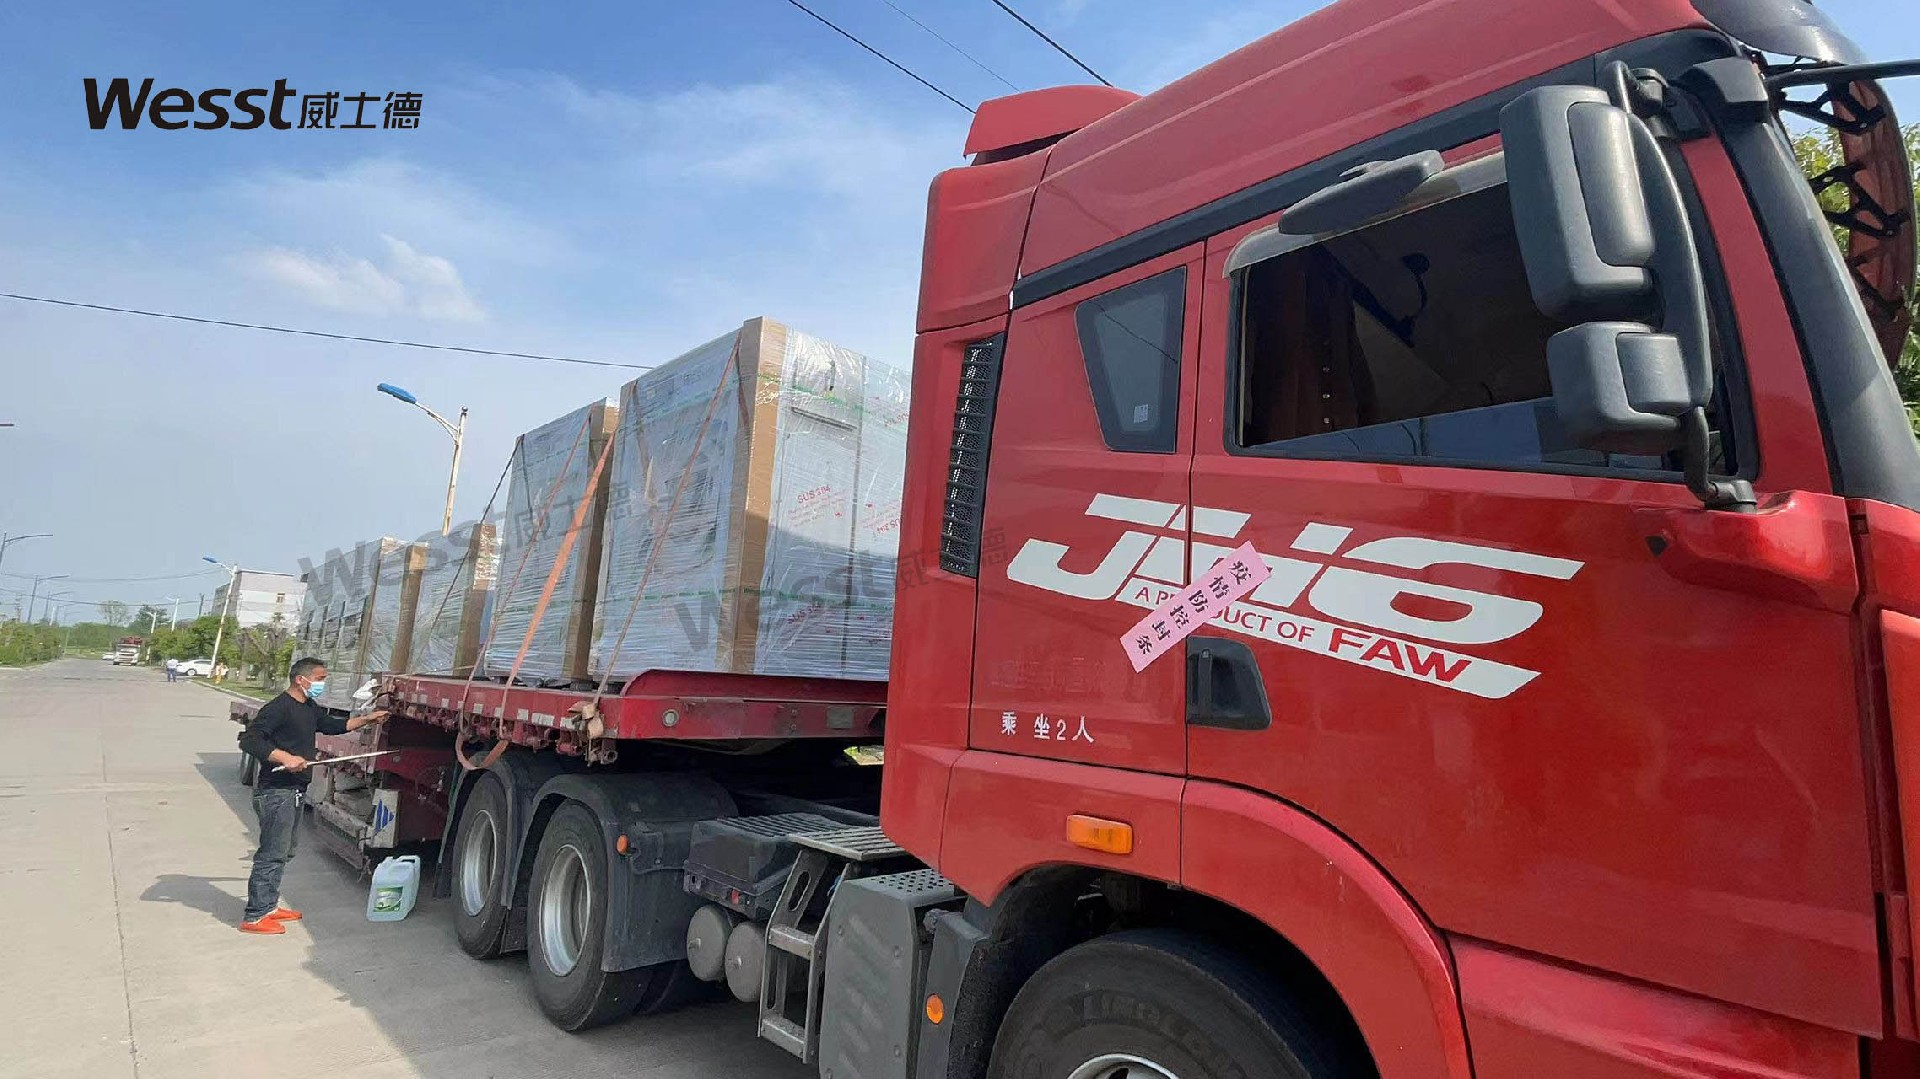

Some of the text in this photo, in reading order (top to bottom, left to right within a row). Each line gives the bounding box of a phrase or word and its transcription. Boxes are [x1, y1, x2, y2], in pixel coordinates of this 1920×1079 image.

[797, 490, 816, 504] SUS
[1135, 587, 1473, 683] A PUCT OF FAW
[1137, 560, 1252, 655] 疫情防控封条
[1001, 711, 1095, 743] 乘坐2人
